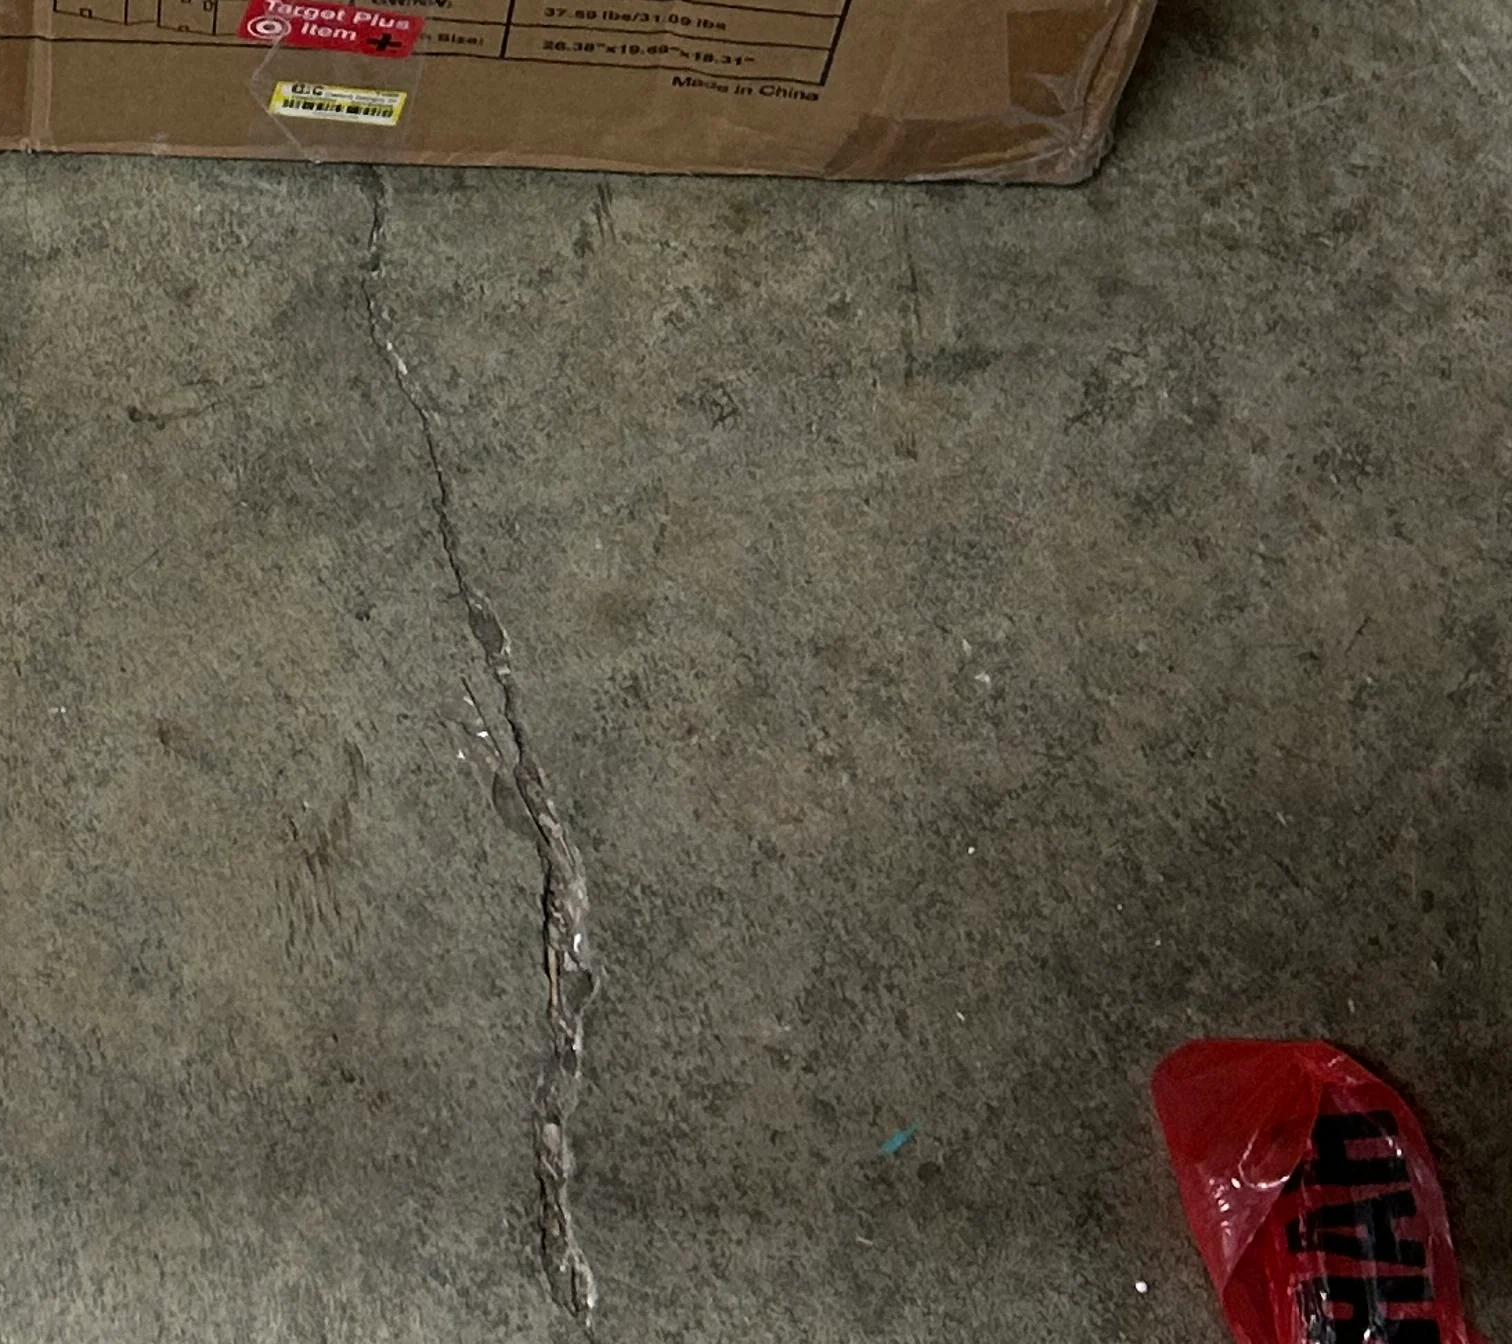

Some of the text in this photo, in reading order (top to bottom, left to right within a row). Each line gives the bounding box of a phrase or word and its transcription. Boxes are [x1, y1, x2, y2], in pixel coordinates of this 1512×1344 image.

[352, 10, 410, 31] Plus
[300, 21, 358, 42] Item
[672, 75, 820, 103] Made in China
